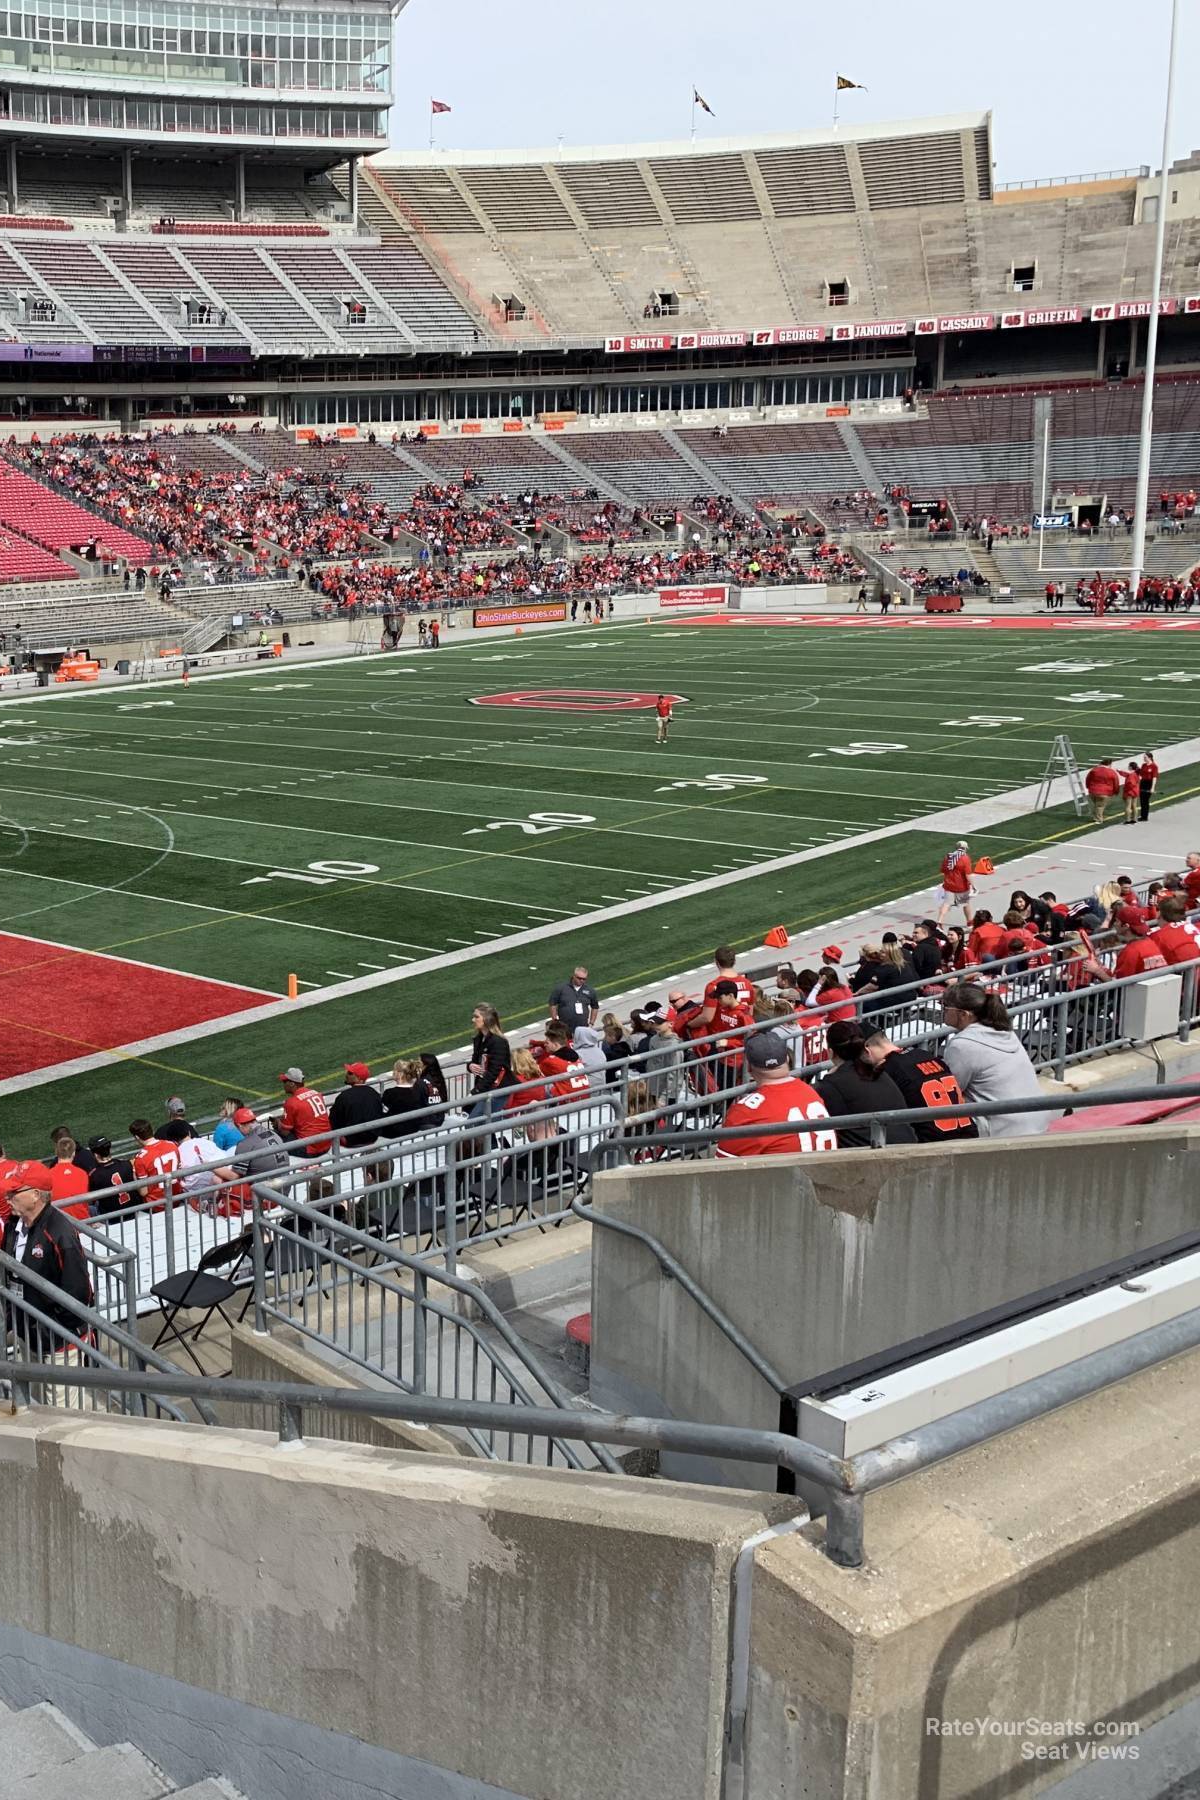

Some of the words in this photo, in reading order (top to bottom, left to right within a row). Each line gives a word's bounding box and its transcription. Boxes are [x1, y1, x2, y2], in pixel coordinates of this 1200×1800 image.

[939, 316, 989, 330] CASSADY
[1027, 310, 1078, 324] GRIFFIN
[757, 332, 770, 343] 27
[779, 329, 819, 341] GEORGE
[854, 323, 907, 337] JANOWICZ
[609, 340, 621, 350] 10
[630, 338, 663, 348] SMITH
[680, 337, 694, 347] 22
[700, 333, 744, 346] HORVATH
[476, 609, 565, 623] OhioStateBuckeyes.com
[826, 742, 910, 756] 40
[671, 774, 769, 791] 30
[486, 812, 597, 835] 20
[266, 860, 381, 885] 10
[307, 1096, 326, 1118] 18
[921, 1075, 971, 1132] 97
[787, 1100, 838, 1152] 18
[154, 1150, 179, 1189] 17
